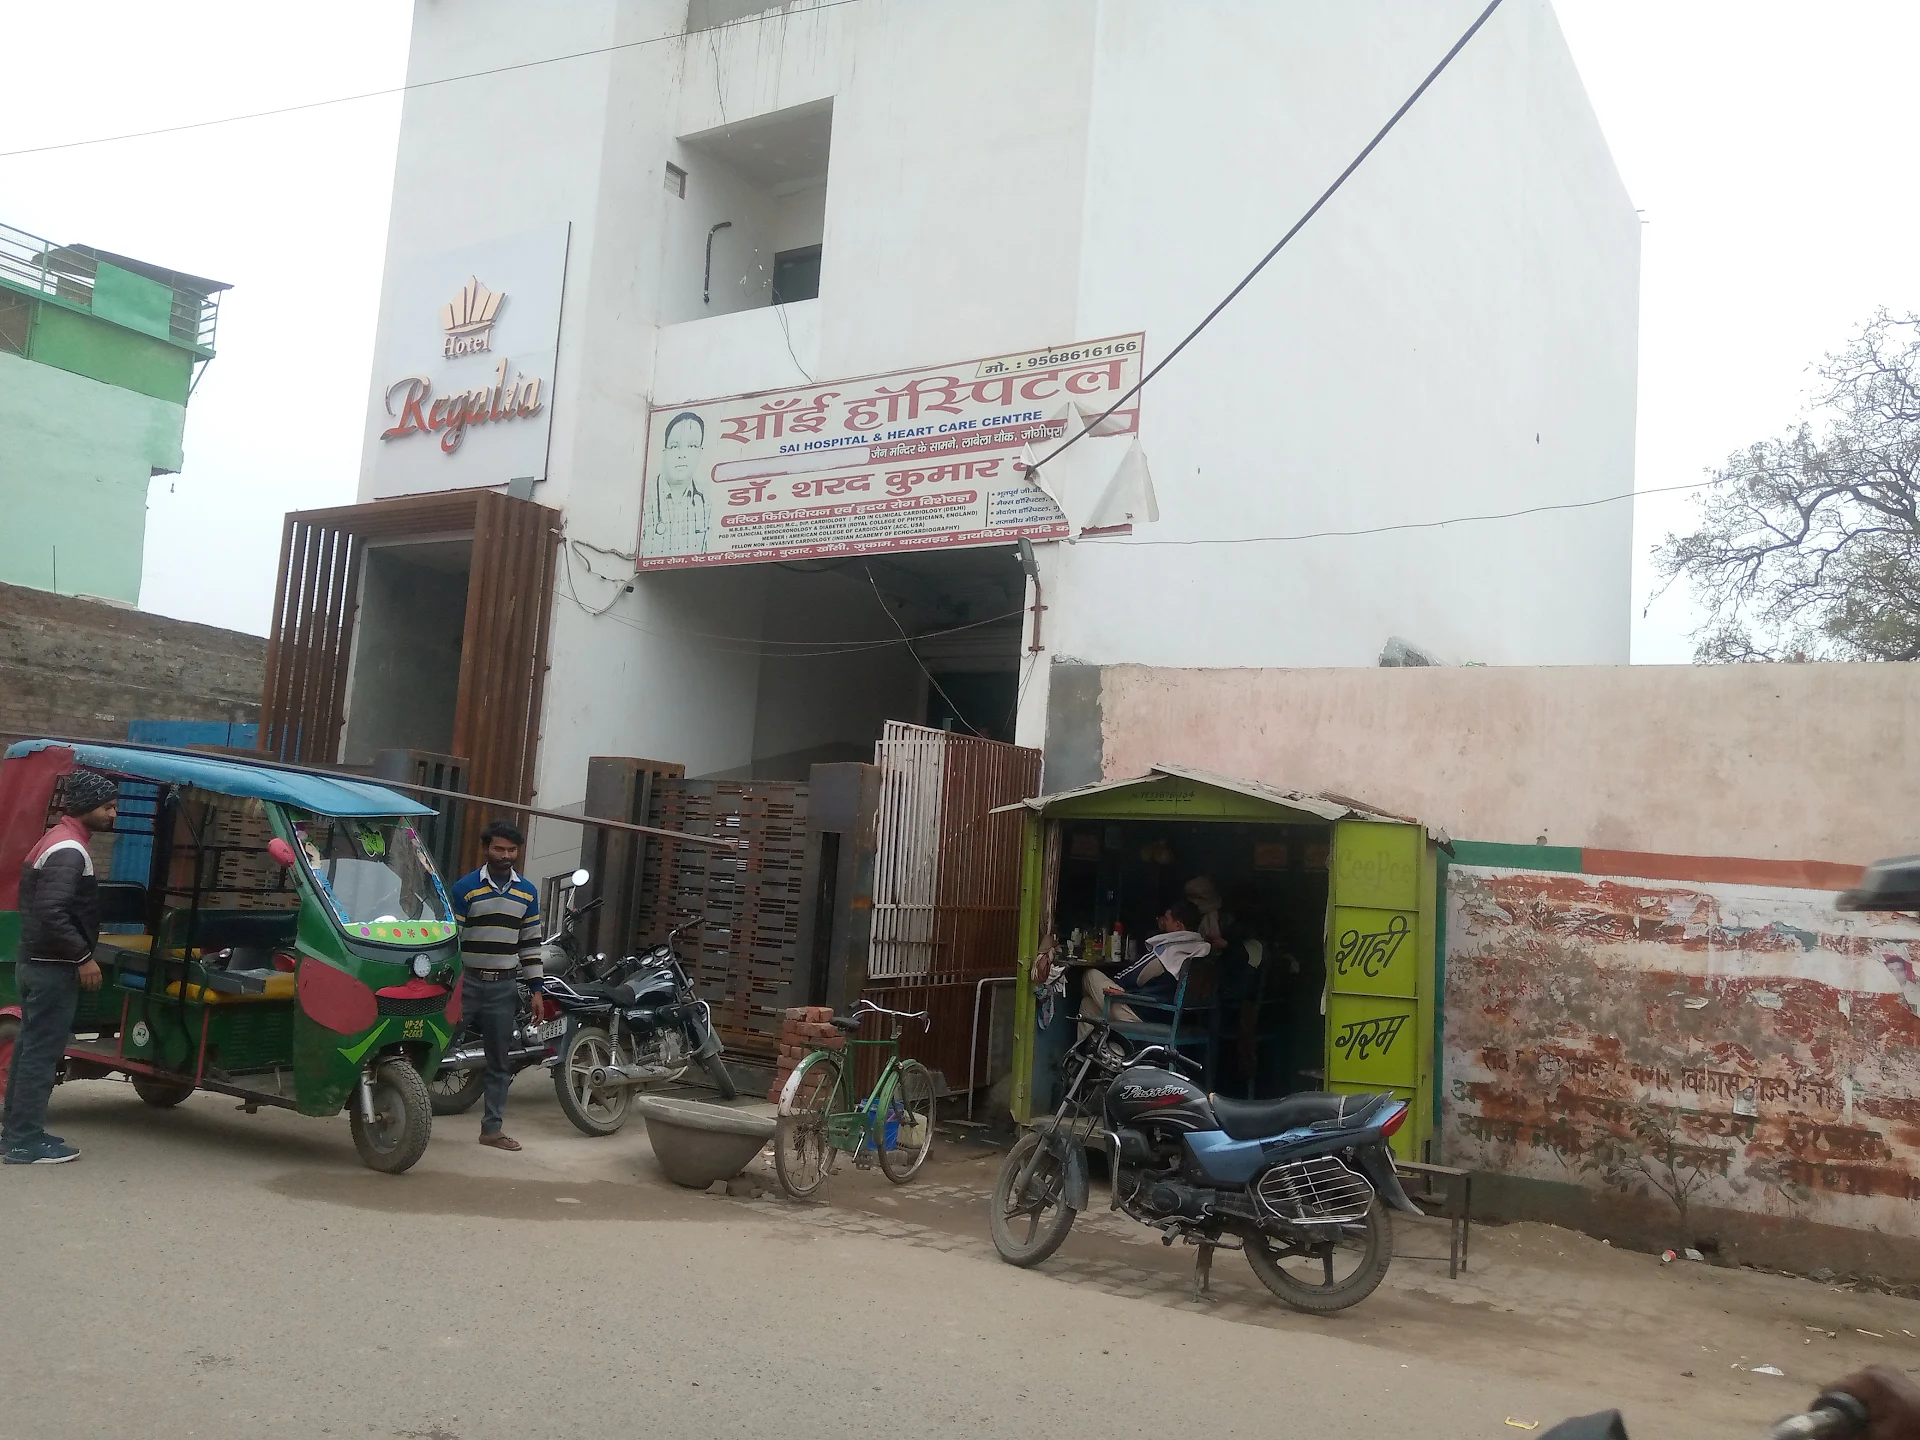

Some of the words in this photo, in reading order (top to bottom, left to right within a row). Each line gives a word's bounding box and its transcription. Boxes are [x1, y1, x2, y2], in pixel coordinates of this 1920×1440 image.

[442, 329, 493, 359] Hotel
[1027, 341, 1137, 367] 9568616166
[379, 357, 545, 455] Regalia
[843, 358, 1128, 432] हॉस्पिटल
[779, 444, 799, 453] SAI
[804, 436, 868, 451] HOSPITAL
[873, 433, 883, 441] &
[887, 425, 934, 440] HEART
[938, 420, 977, 432] CARE
[982, 411, 1042, 427] CENTRE
[870, 446, 887, 459] जैन
[889, 442, 916, 458] मन्दिर
[917, 441, 927, 453] के
[727, 479, 777, 506] डॉ.
[791, 473, 875, 499] शरद
[885, 458, 1004, 496] कुमार
[726, 514, 760, 526] वरिष्ठ
[834, 503, 856, 515] एवं
[856, 502, 887, 514] हृदय
[890, 499, 916, 510] रोग
[919, 493, 972, 506] विशेषज्ञ
[810, 517, 847, 525] CARDIOLOGY
[875, 511, 902, 519] CLINICAL
[903, 508, 943, 516] CARDIOLOGY
[943, 505, 967, 513] (DELHI)
[869, 518, 896, 526] COLLEGE
[906, 514, 945, 522] PHYSICIANS,
[946, 510, 978, 518] ENGLAND)
[788, 531, 818, 539] AMERICAN
[854, 525, 892, 533] CARDIOLOGY
[795, 536, 831, 544] CARDIOLOGY
[893, 525, 960, 536] ECHOCARDIOGRAPHY)
[642, 559, 664, 567] हृदय
[1335, 915, 1411, 978] शाही
[1335, 1014, 1410, 1061] गरम
